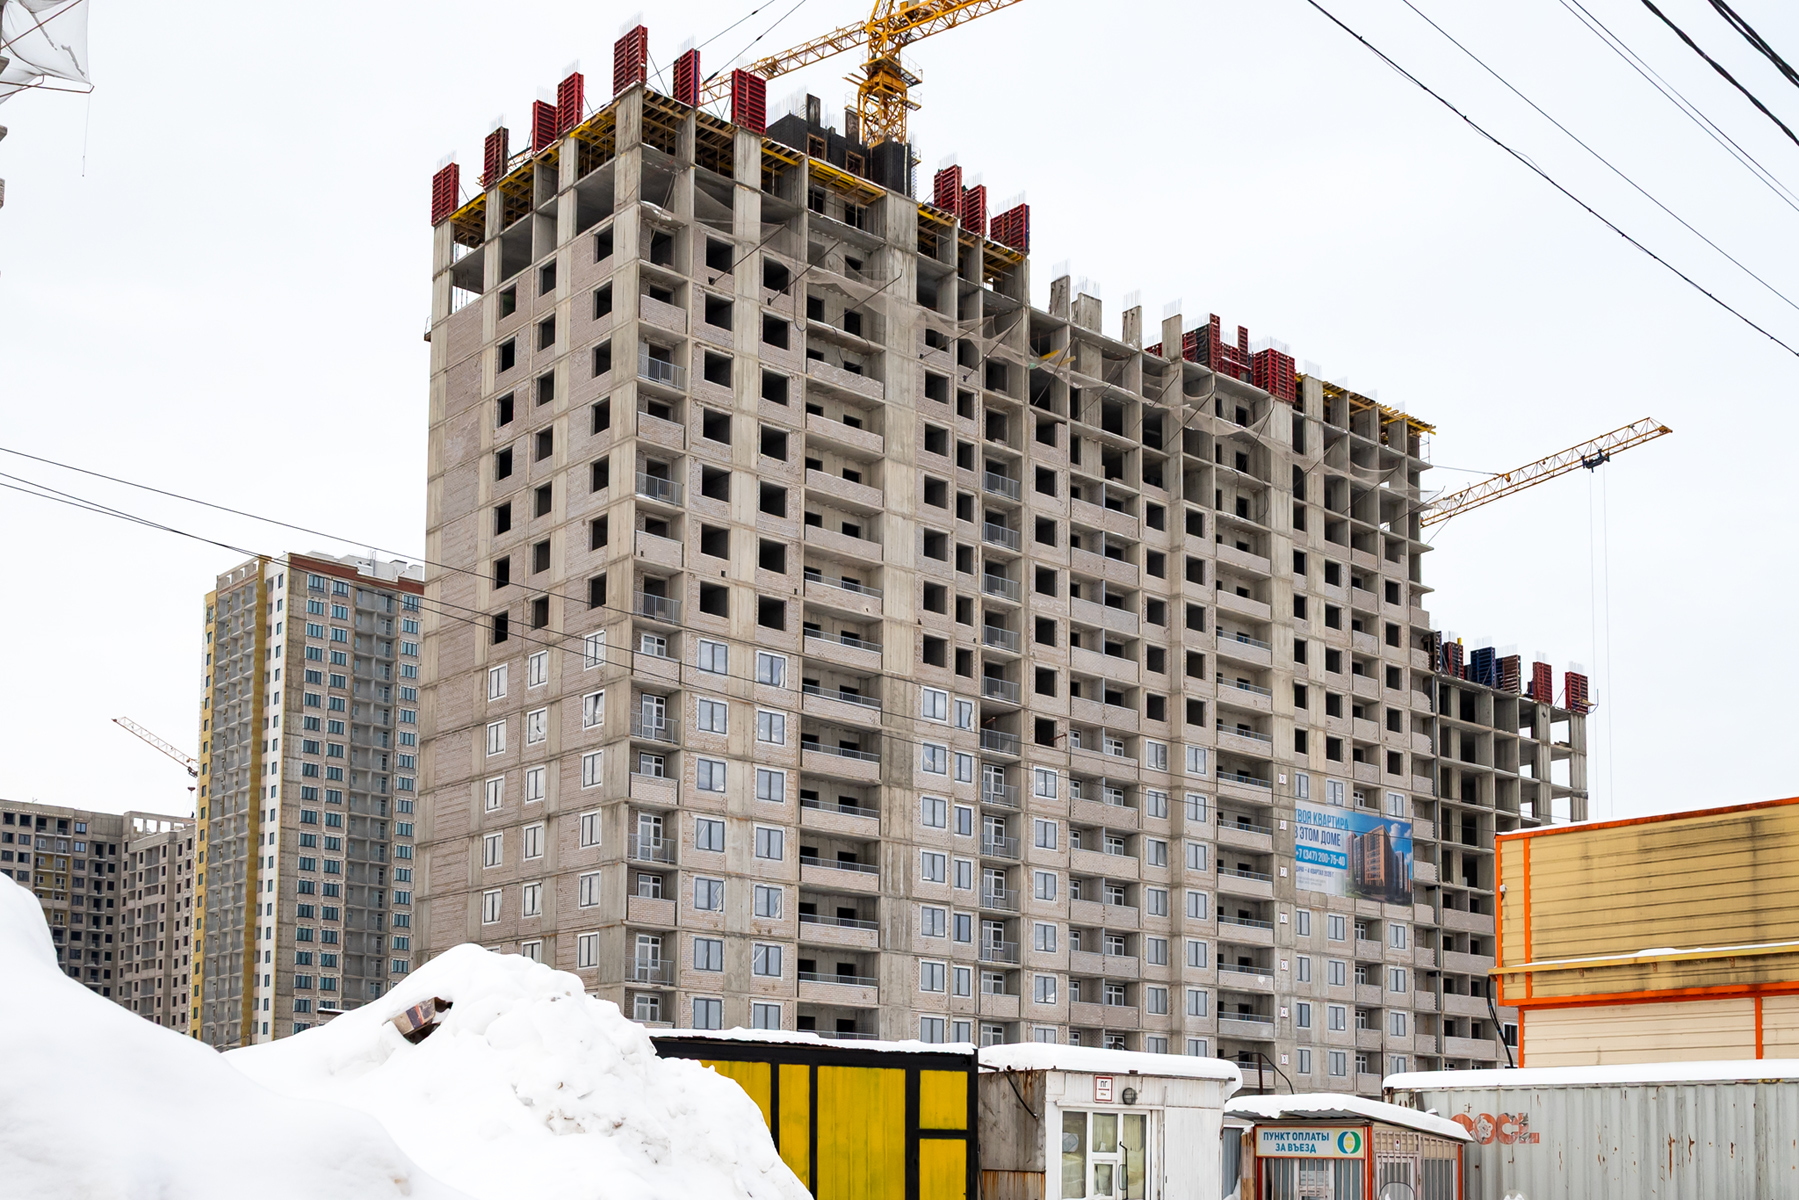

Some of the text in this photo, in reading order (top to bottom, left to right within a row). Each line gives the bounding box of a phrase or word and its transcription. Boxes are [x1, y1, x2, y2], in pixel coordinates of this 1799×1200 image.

[1295, 808, 1349, 831] ТВОЯ КВАРТИРА
[1299, 826, 1319, 842] ЭТОМ
[1320, 830, 1341, 847] ДОМЕ
[1303, 849, 1318, 863] (347)
[1263, 1132, 1330, 1141] ПУНКТ ОПЛАТЫ
[1275, 1143, 1317, 1153] ЗА ВЪЕЗД
